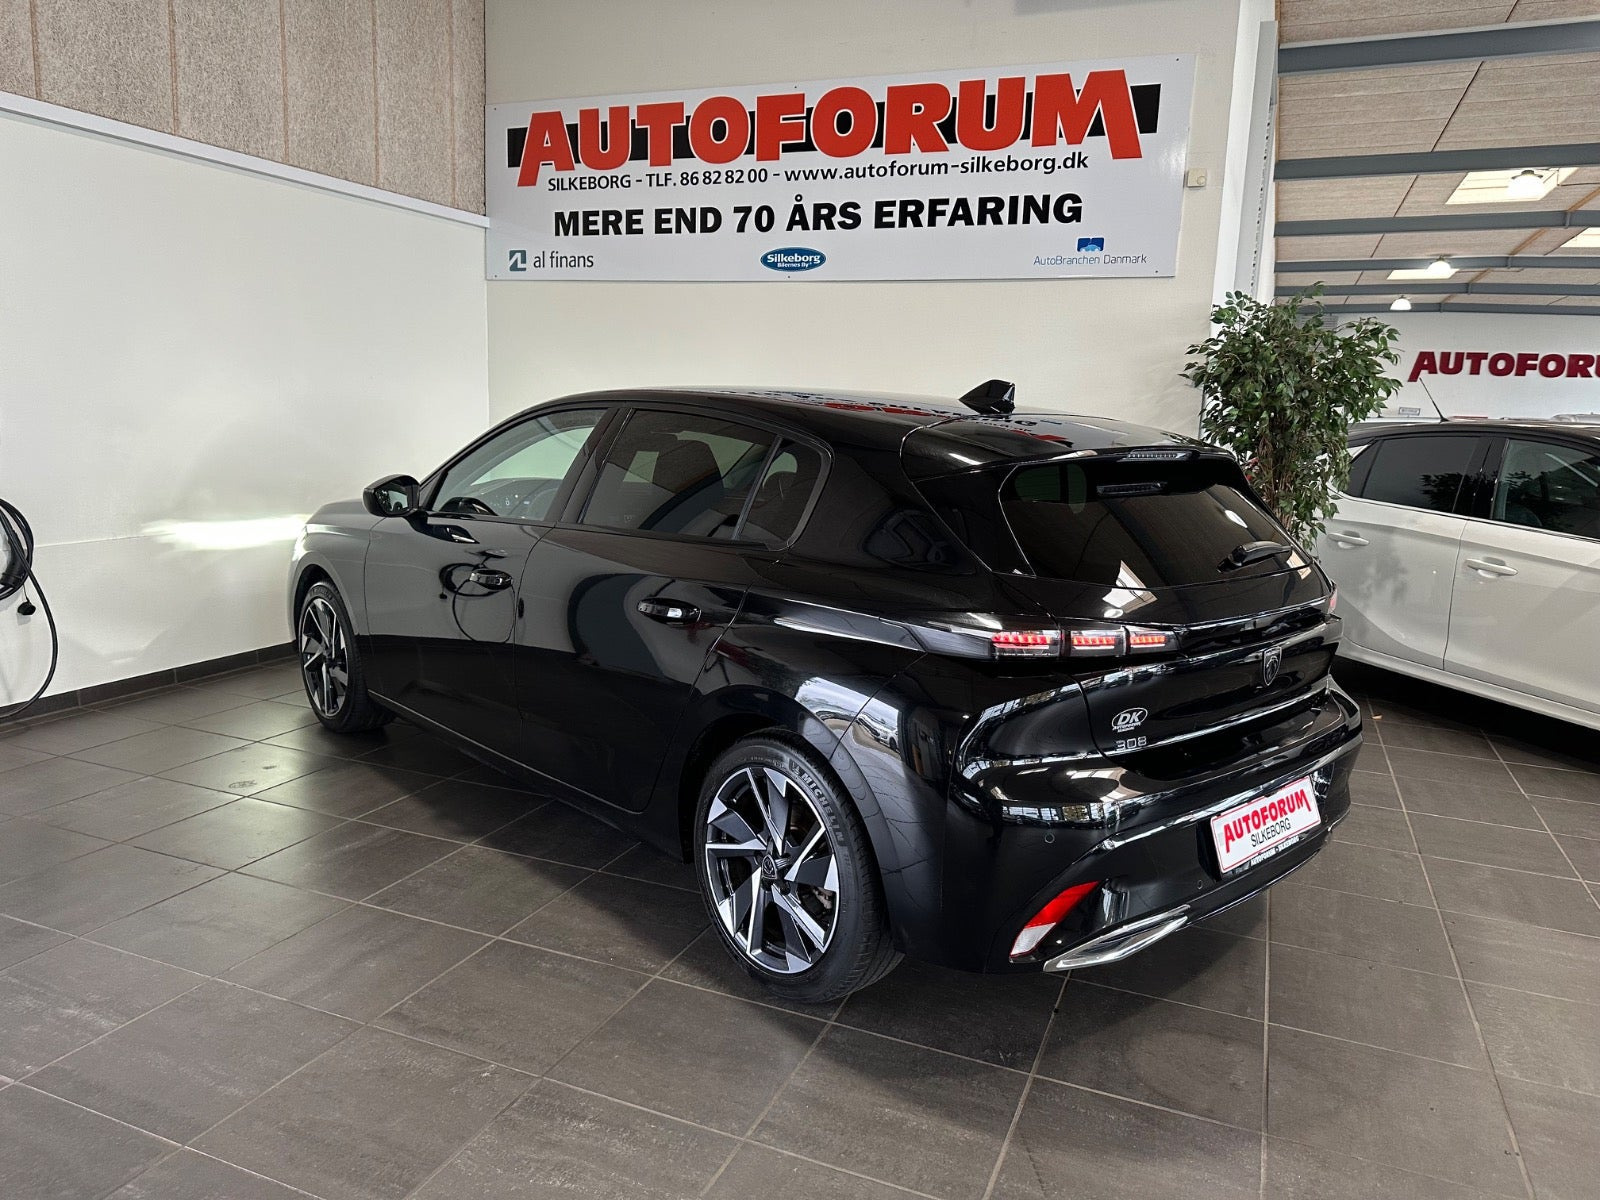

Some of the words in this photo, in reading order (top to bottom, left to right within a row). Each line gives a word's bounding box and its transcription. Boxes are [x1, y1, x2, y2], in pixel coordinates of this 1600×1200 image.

[516, 69, 1143, 187] AUTOFORUM
[548, 174, 631, 191] SILKEBORG
[646, 172, 676, 187] TLF.
[784, 151, 1089, 181] www.autoforum-silkeborg.dk
[554, 209, 644, 237] MERE
[654, 206, 722, 235] END
[733, 205, 775, 233] 70
[785, 193, 861, 231] ÅRS
[874, 193, 1083, 229] ERFARING
[533, 251, 546, 268] al
[550, 251, 594, 268] finans
[767, 253, 820, 264] Silkeborg
[1033, 255, 1100, 266] AutoBranchen
[1103, 254, 1147, 264] Danmark
[1407, 351, 1600, 382] AUTOFOR
[1117, 710, 1143, 725] DK
[1116, 736, 1147, 751] 308
[800, 772, 845, 842] MICHELIN
[1223, 789, 1311, 853] AUTOFORUM
[1251, 818, 1291, 847] SILKEBORG
